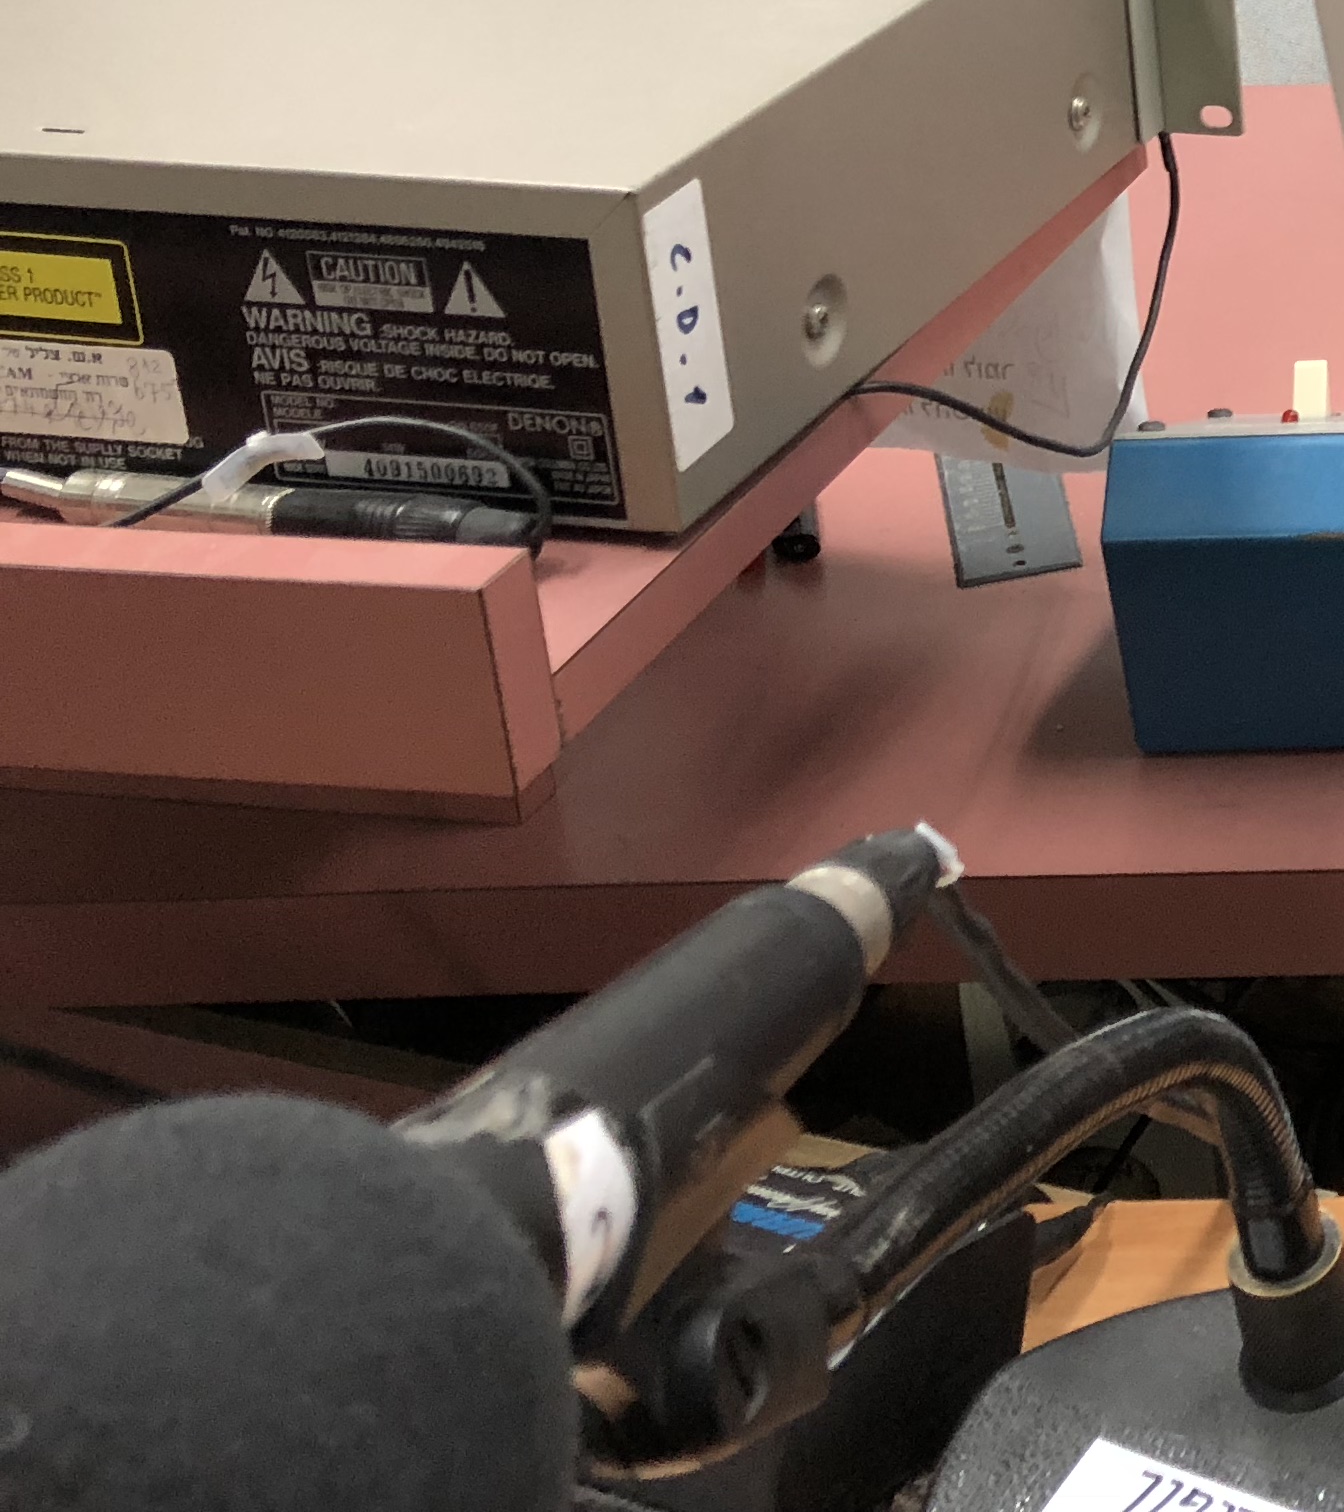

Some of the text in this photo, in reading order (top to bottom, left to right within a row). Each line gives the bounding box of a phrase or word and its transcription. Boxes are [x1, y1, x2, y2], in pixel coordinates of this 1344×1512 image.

[320, 256, 418, 286] CAUTION
[240, 305, 372, 336] WARNING
[252, 347, 311, 372] AVIS
